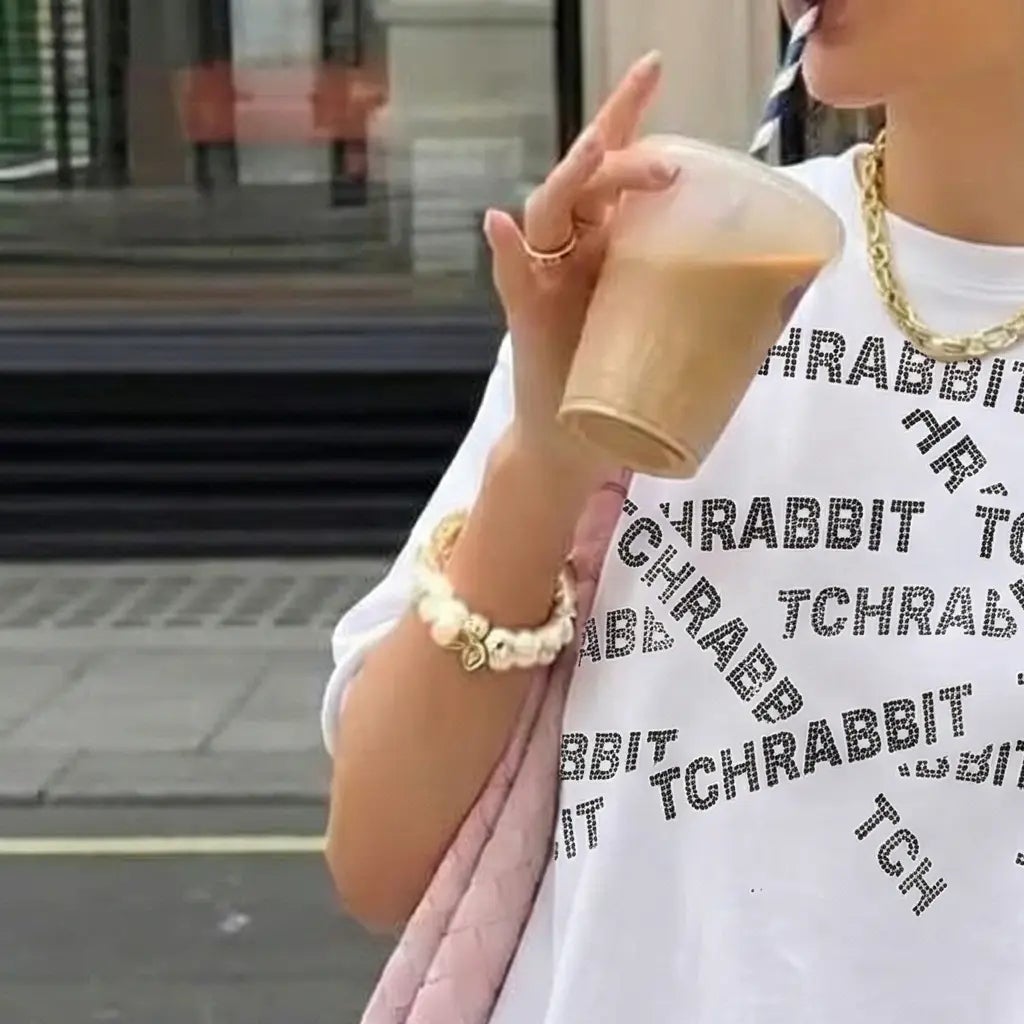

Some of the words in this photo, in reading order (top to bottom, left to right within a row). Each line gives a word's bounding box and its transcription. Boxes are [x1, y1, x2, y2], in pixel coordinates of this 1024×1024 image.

[555, 796, 605, 860] IT
[649, 683, 973, 821] TCHRABBIT
[617, 498, 804, 724] CHRABB
[854, 792, 948, 917] TCH
